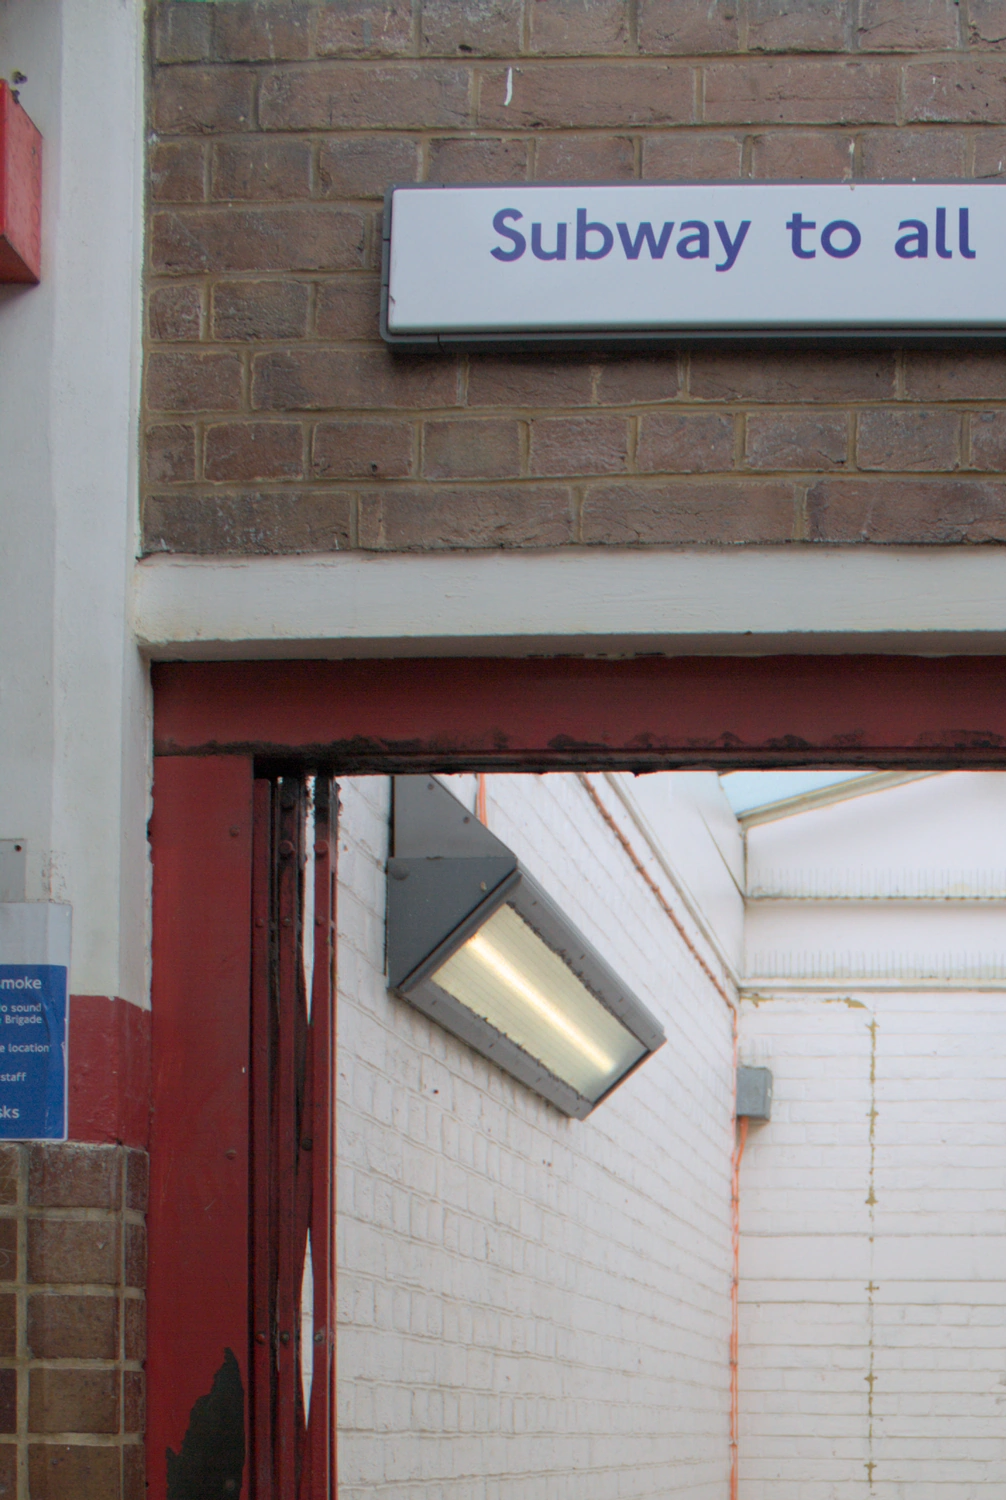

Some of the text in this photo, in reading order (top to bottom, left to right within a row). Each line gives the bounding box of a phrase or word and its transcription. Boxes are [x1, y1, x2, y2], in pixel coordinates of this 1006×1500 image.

[490, 208, 751, 272] Subway
[786, 213, 862, 260] to
[894, 207, 976, 260] all
[0, 975, 42, 990] moke
[11, 1002, 42, 1013] sound
[4, 1014, 43, 1027] Brigade
[8, 1042, 50, 1053] location
[0, 1071, 27, 1082] staff
